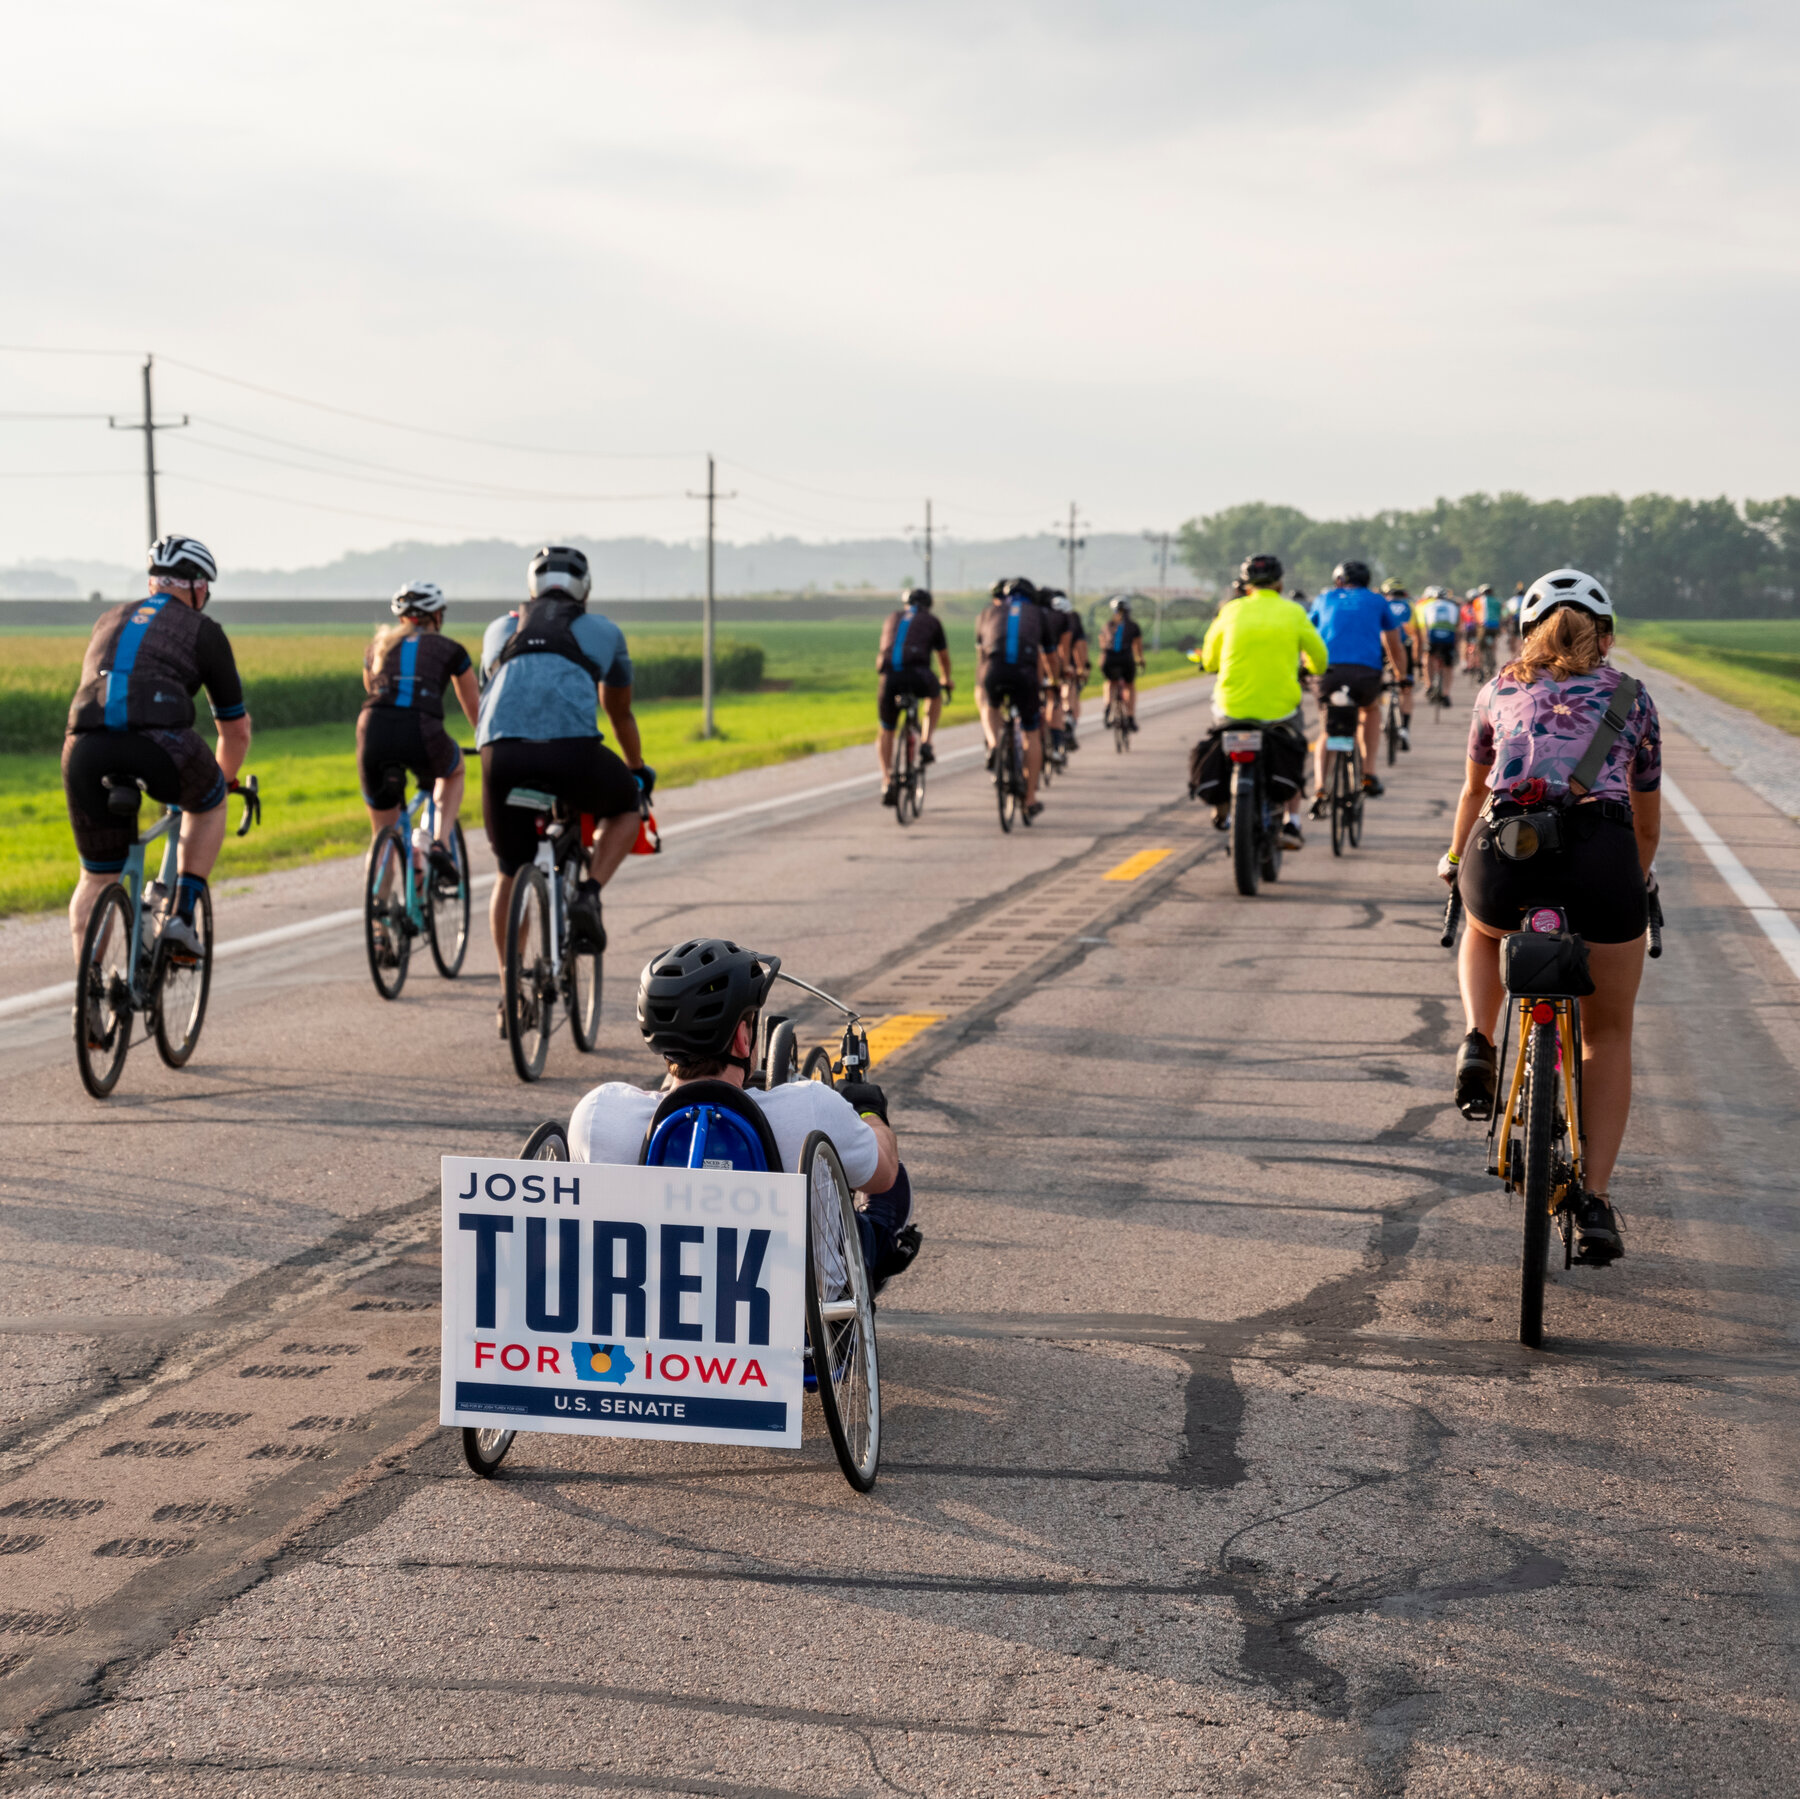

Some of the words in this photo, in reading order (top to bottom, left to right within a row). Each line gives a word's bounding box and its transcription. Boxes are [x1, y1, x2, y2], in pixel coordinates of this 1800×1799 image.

[459, 1172, 580, 1205] JOSH
[458, 1213, 771, 1346] TUREK
[474, 1341, 561, 1375] FOR
[644, 1351, 769, 1388] IOWA
[554, 1395, 591, 1413] U.S.
[600, 1398, 686, 1418] SENATE
